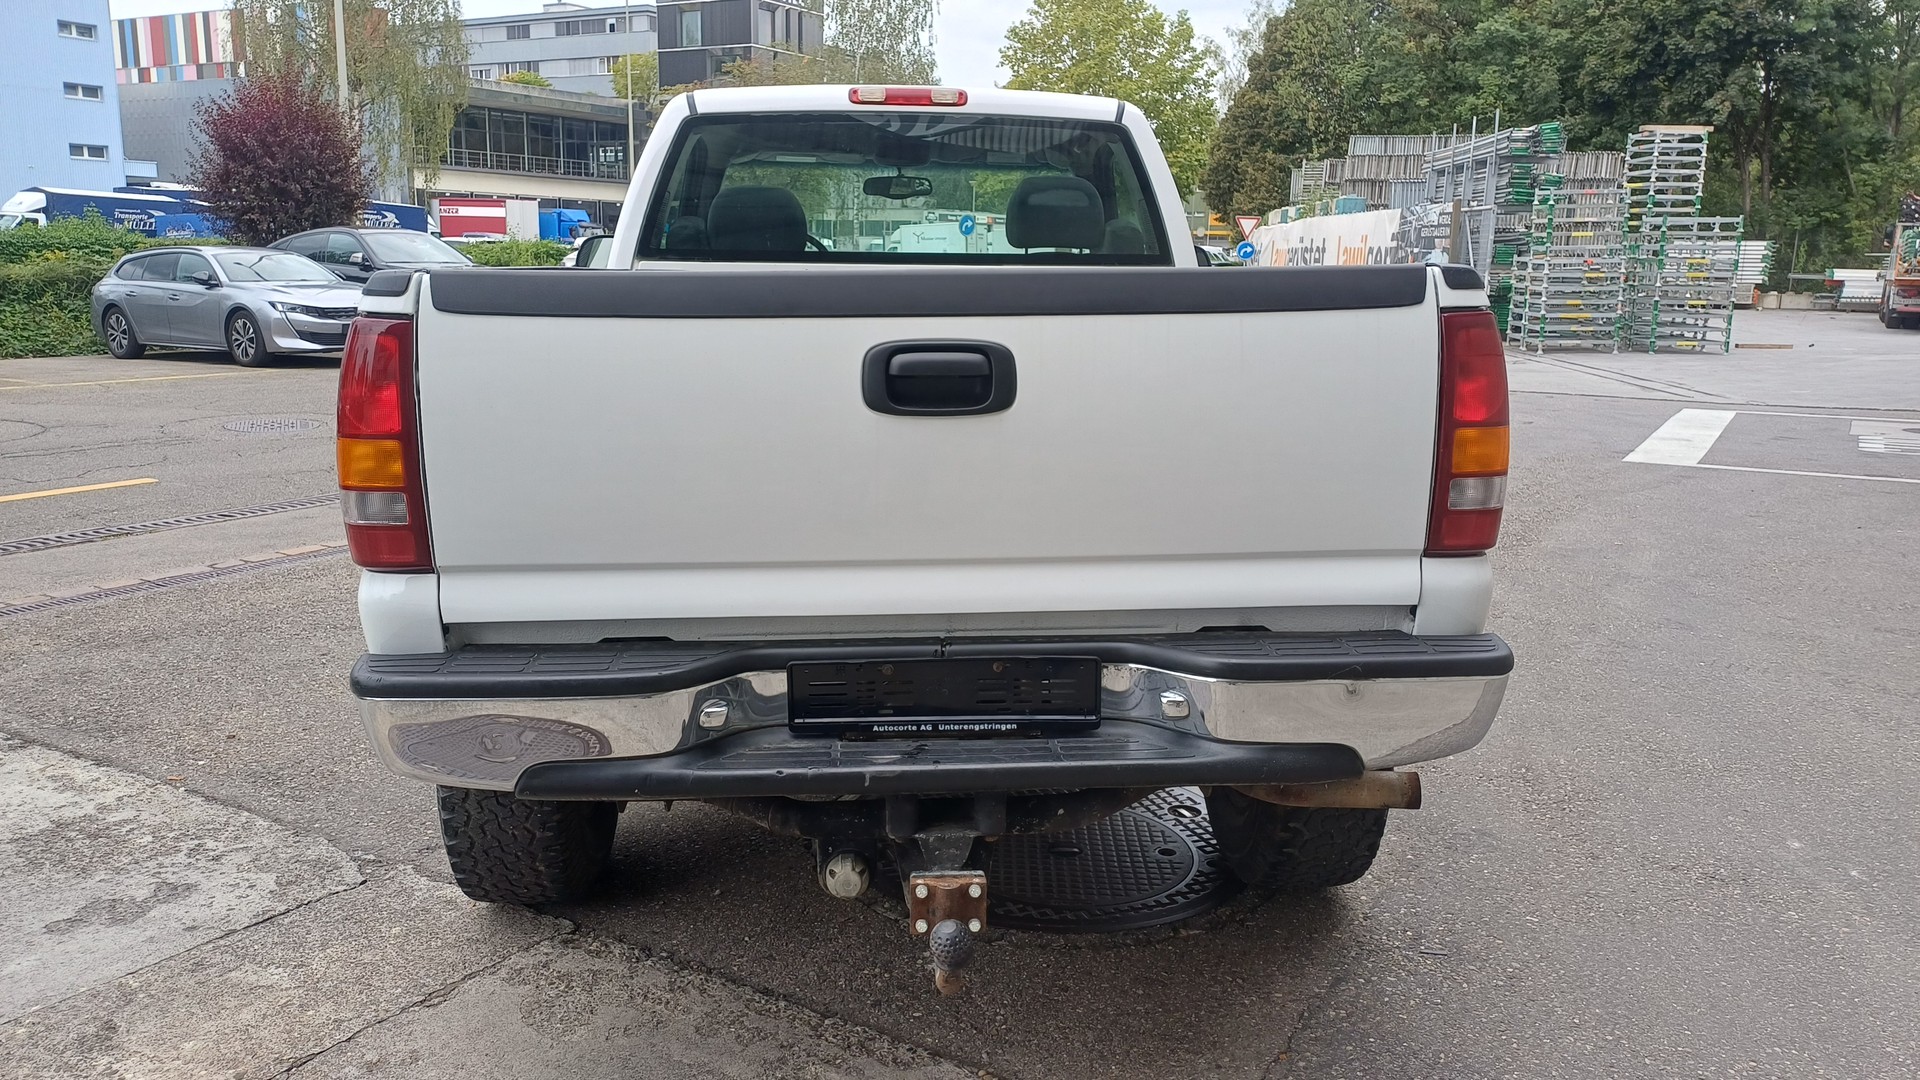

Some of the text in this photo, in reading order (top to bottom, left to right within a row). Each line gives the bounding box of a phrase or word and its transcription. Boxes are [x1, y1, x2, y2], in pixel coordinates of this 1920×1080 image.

[114, 212, 148, 221] Transporte
[872, 724, 918, 732] Autocorte
[938, 723, 1018, 732] Unterengstringen
